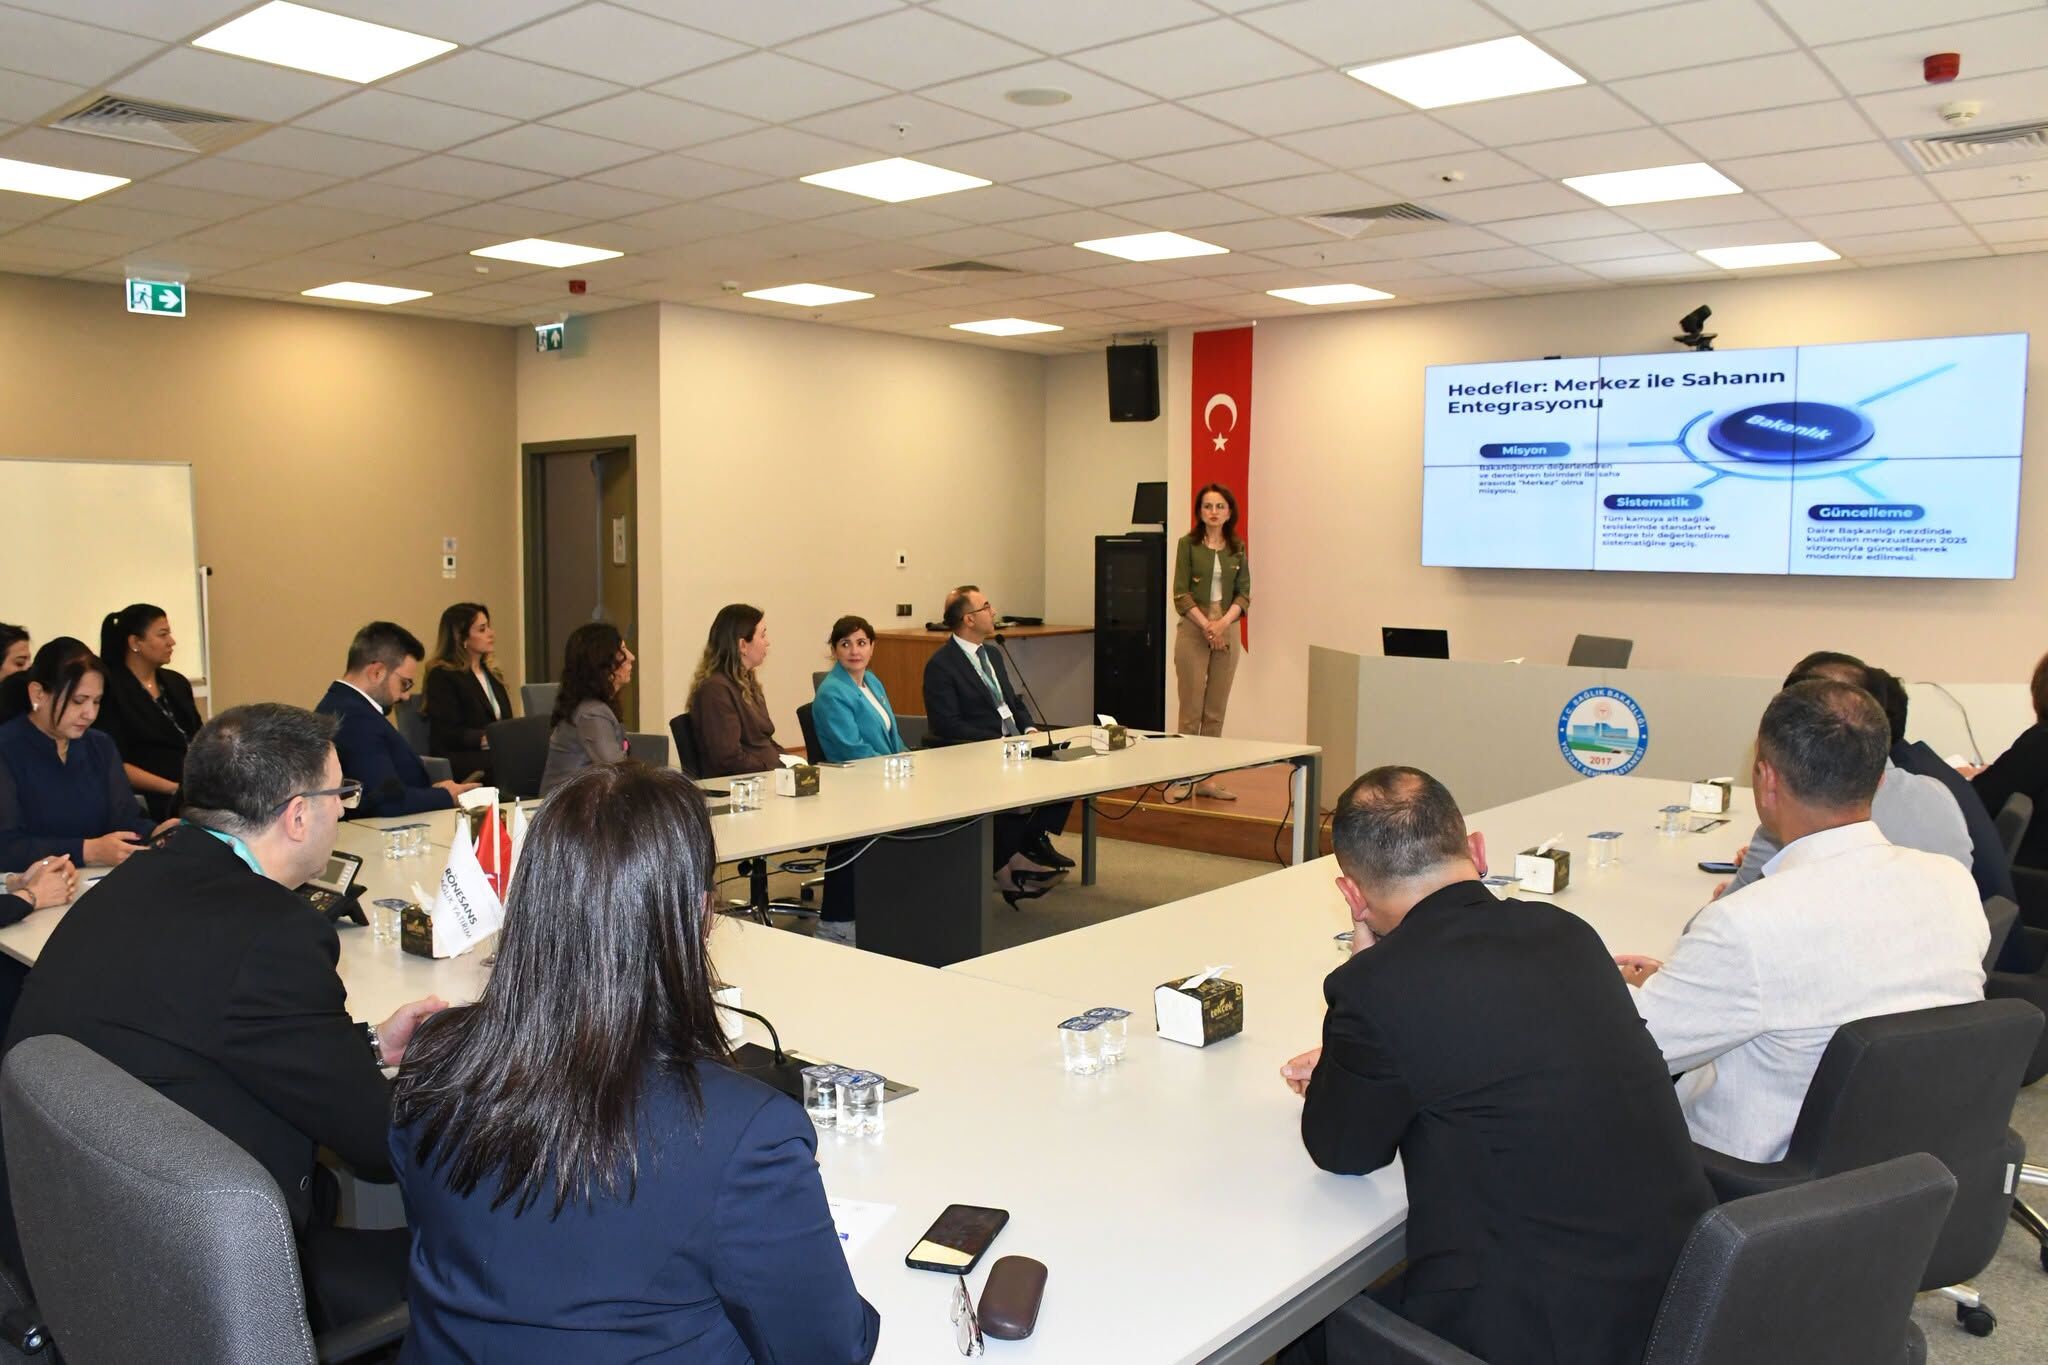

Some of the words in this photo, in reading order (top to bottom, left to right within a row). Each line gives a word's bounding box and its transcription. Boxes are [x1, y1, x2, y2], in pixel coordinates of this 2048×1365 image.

[1448, 380, 1548, 397] Hedefler:
[1554, 376, 1640, 392] Merkez
[1647, 373, 1675, 389] ile
[1682, 371, 1785, 387] Sahanın
[1448, 398, 1604, 415] Entegrasyonu
[1745, 414, 1832, 440] Bakanlık
[1502, 445, 1547, 457] Misyon
[1616, 496, 1690, 508] Sistematik
[1819, 506, 1913, 518] Güncelleme
[1603, 514, 1624, 522] Tüm
[1602, 523, 1658, 531] tesislerinde
[1660, 523, 1702, 531] standart
[1807, 526, 1835, 535] Daire
[1838, 526, 1896, 536] Başkanlığı
[1899, 526, 1952, 535] nezdinde
[1602, 532, 1639, 540] entegre
[1657, 531, 1730, 540] değerlendirme
[1806, 535, 1859, 543] kullanılan
[1862, 535, 1936, 544] mevzuatların
[1939, 536, 1968, 544] 2025
[1805, 544, 1864, 553] vizyonuyla
[1866, 544, 1949, 554] güncellenerek
[1805, 552, 1863, 561] modernize
[1561, 740, 1582, 770] YOZGAT
[1589, 755, 1612, 766] 2017
[445, 867, 478, 925] RÖNESANS
